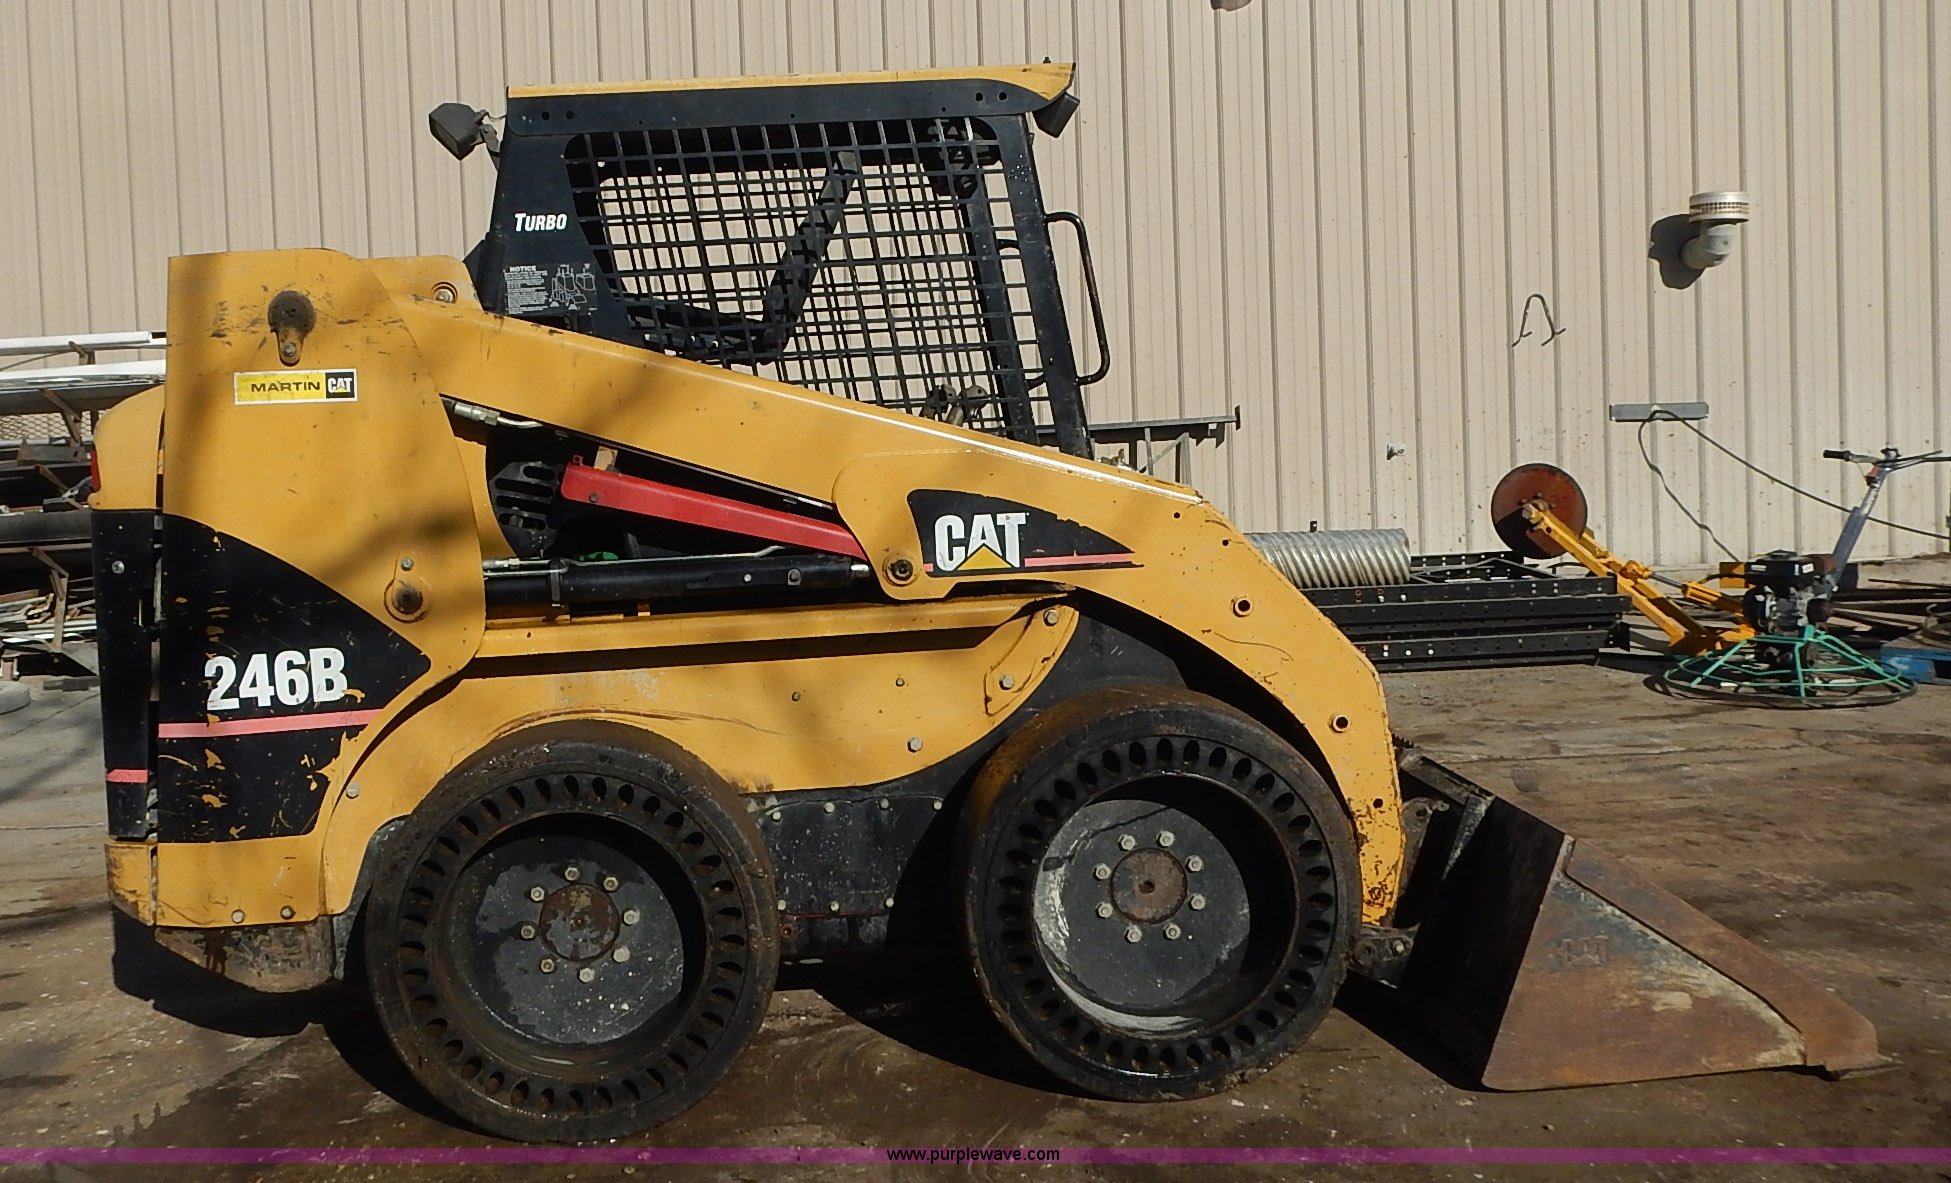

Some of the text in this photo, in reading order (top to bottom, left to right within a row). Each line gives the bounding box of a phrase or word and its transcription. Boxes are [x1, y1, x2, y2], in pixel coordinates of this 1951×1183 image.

[509, 265, 537, 273] NOTICE
[251, 377, 353, 393] MARTIN CAT
[934, 512, 1026, 571] CAT
[204, 647, 348, 711] 246B
